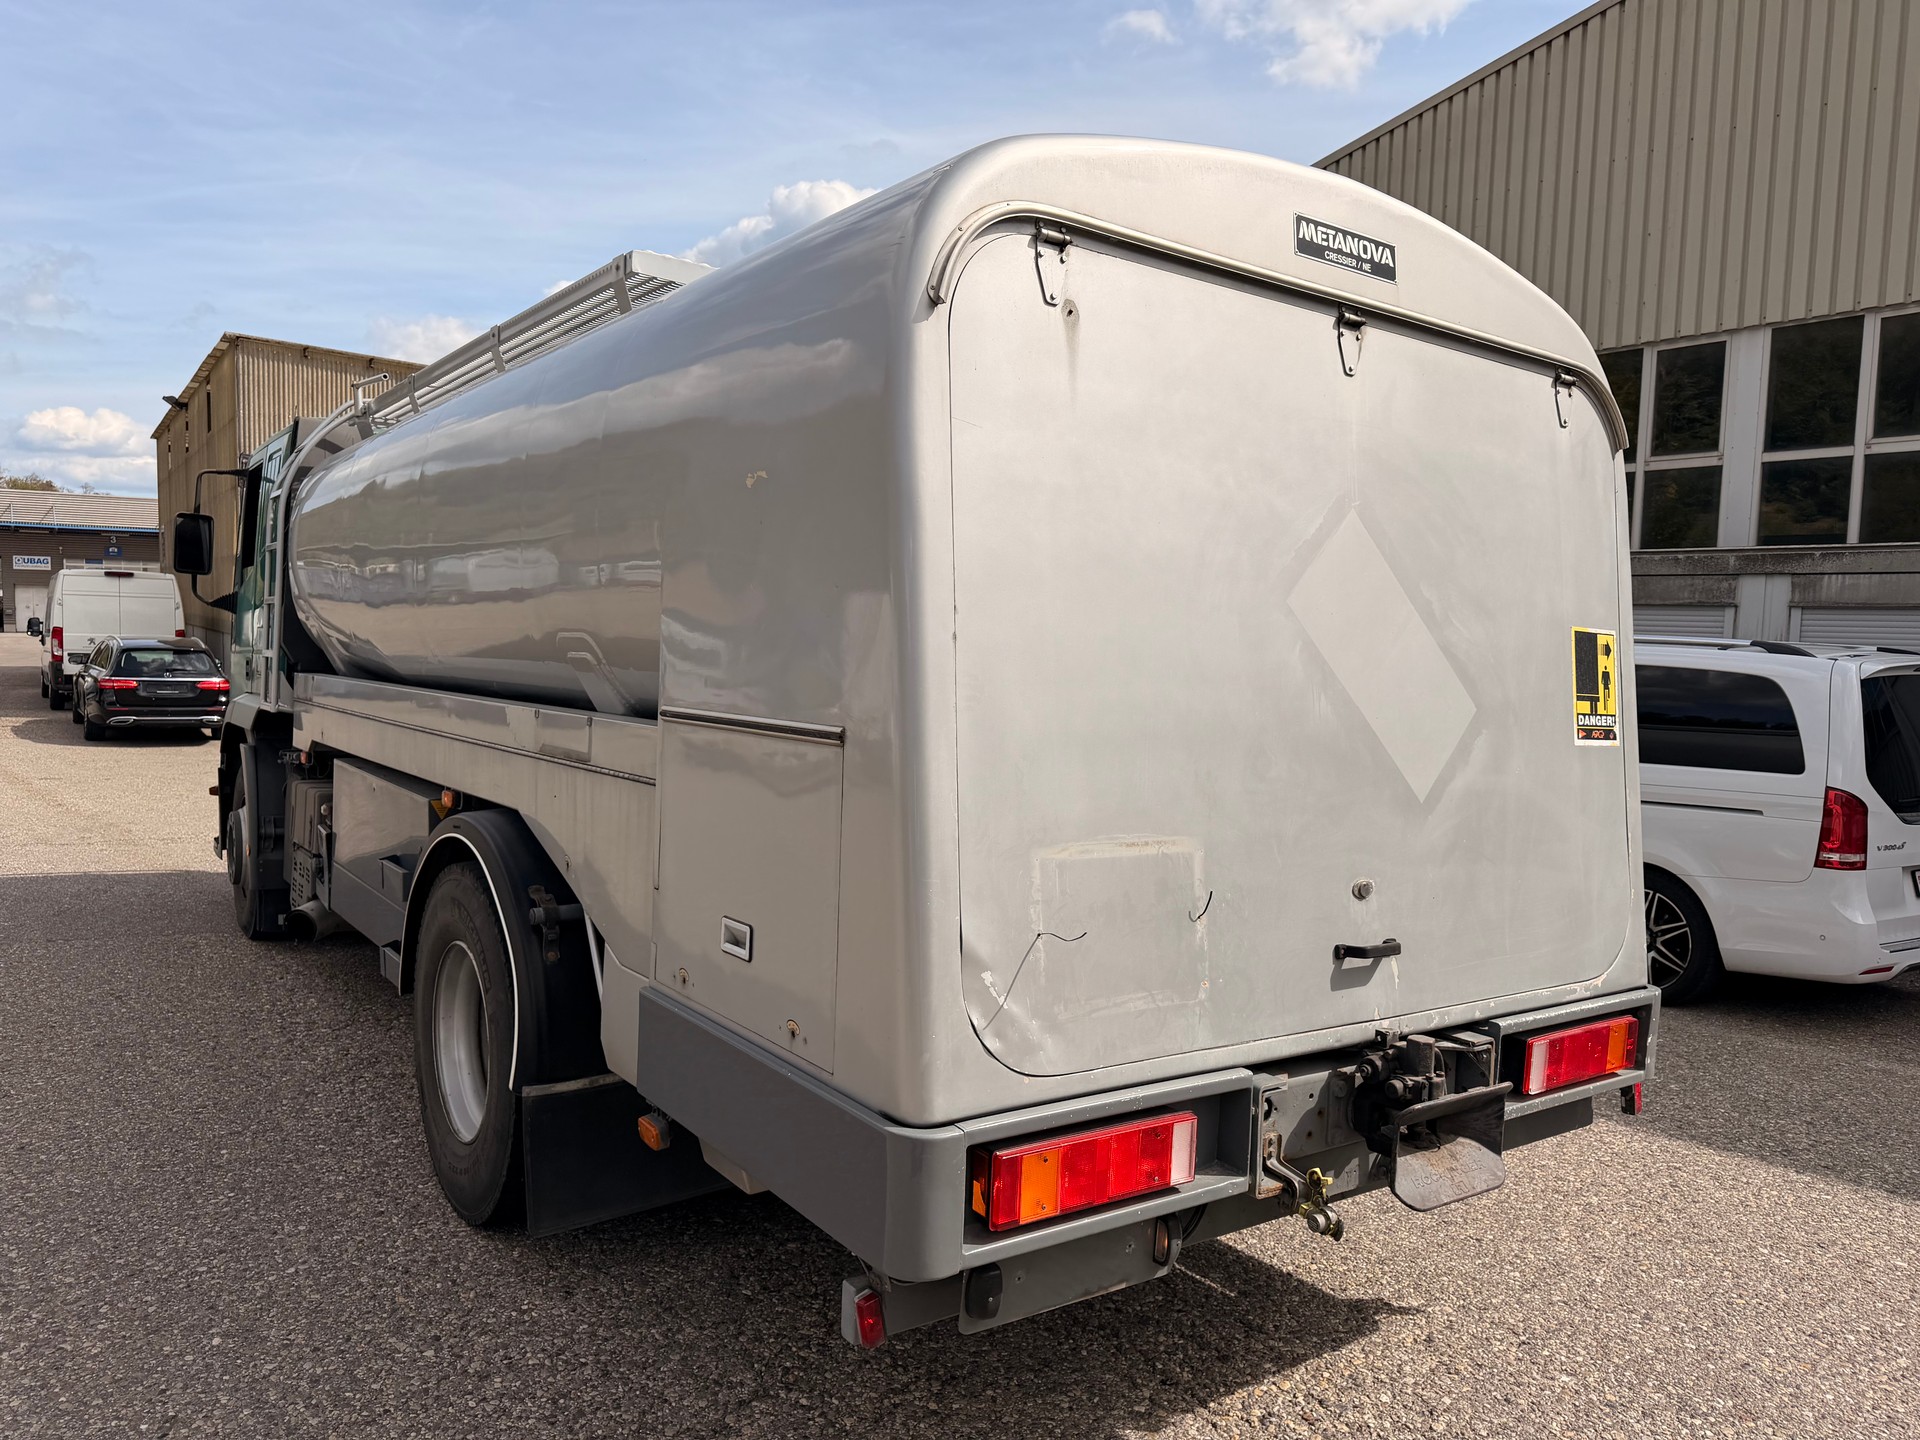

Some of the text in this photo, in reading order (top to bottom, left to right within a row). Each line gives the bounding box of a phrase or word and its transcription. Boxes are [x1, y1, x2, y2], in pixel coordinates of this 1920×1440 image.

[1298, 220, 1394, 267] METANOVA
[1324, 251, 1357, 268] CRESSIER
[1362, 262, 1372, 272] NE
[110, 535, 117, 544] 3
[1578, 714, 1616, 727] DANGER!
